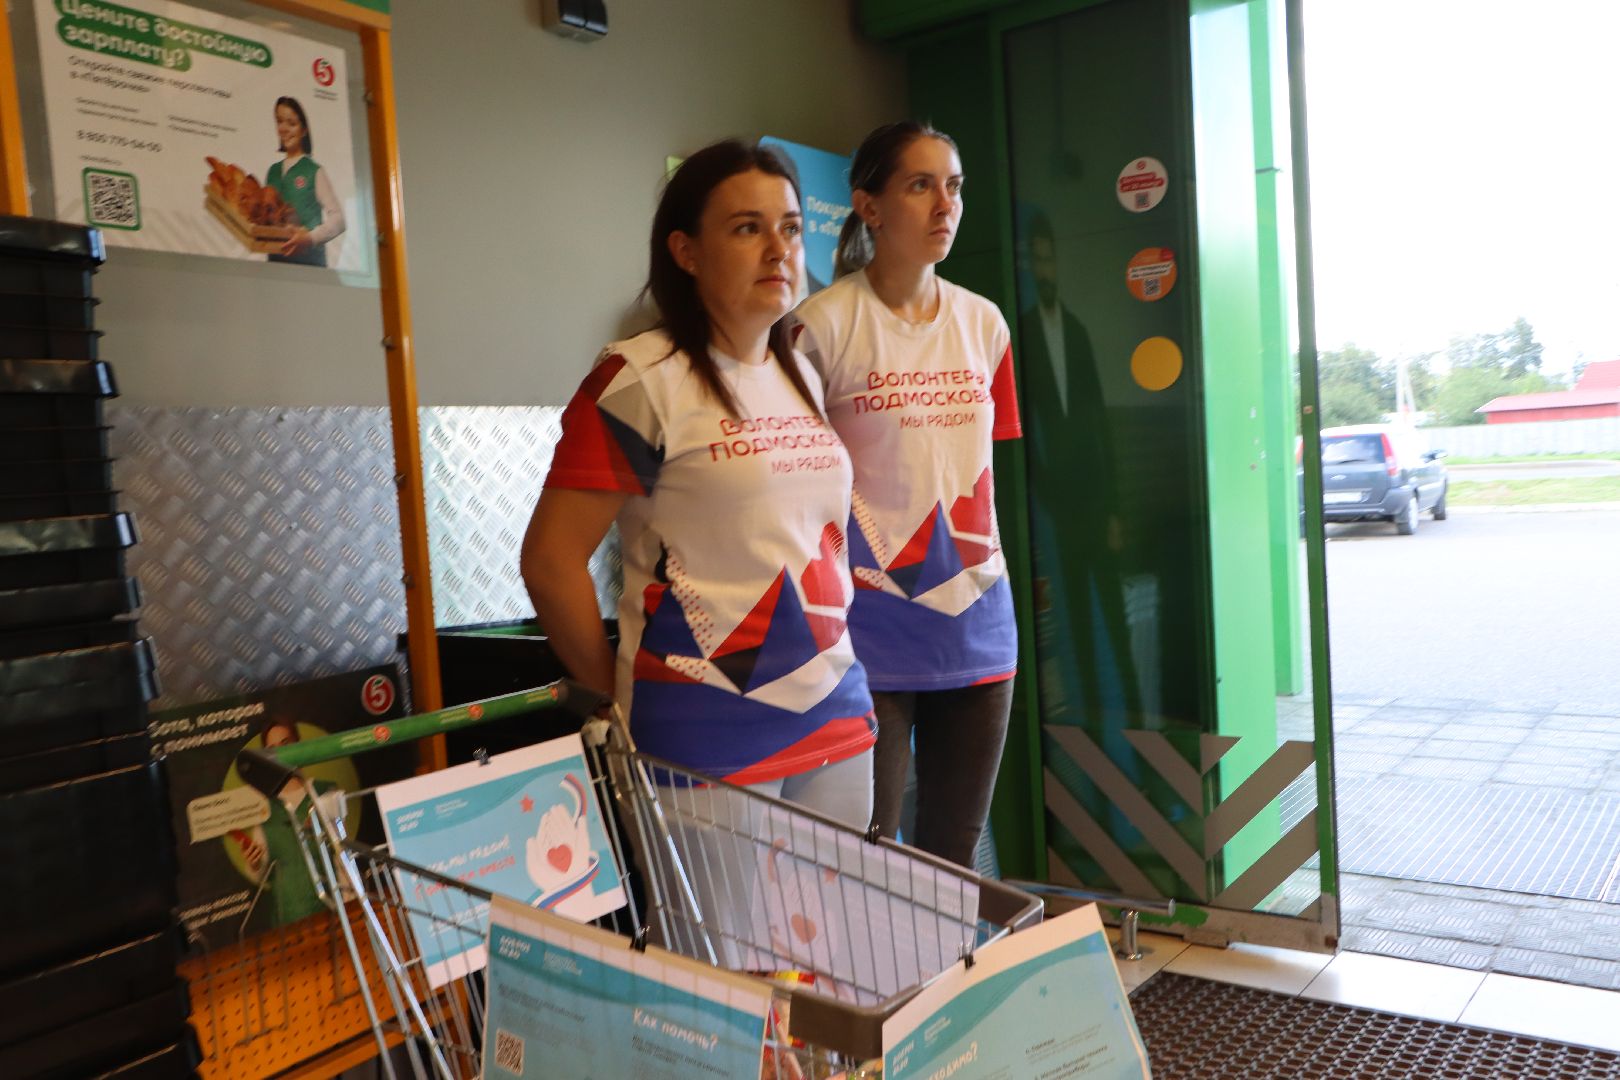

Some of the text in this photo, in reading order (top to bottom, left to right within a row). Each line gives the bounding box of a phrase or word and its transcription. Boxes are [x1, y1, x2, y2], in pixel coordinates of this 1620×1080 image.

[62, 0, 267, 62] Цените достойную
[64, 25, 186, 67] зарплату?
[901, 412, 976, 429] МЫ РЯДОМ
[772, 455, 841, 474] МЫ РЯДОМ
